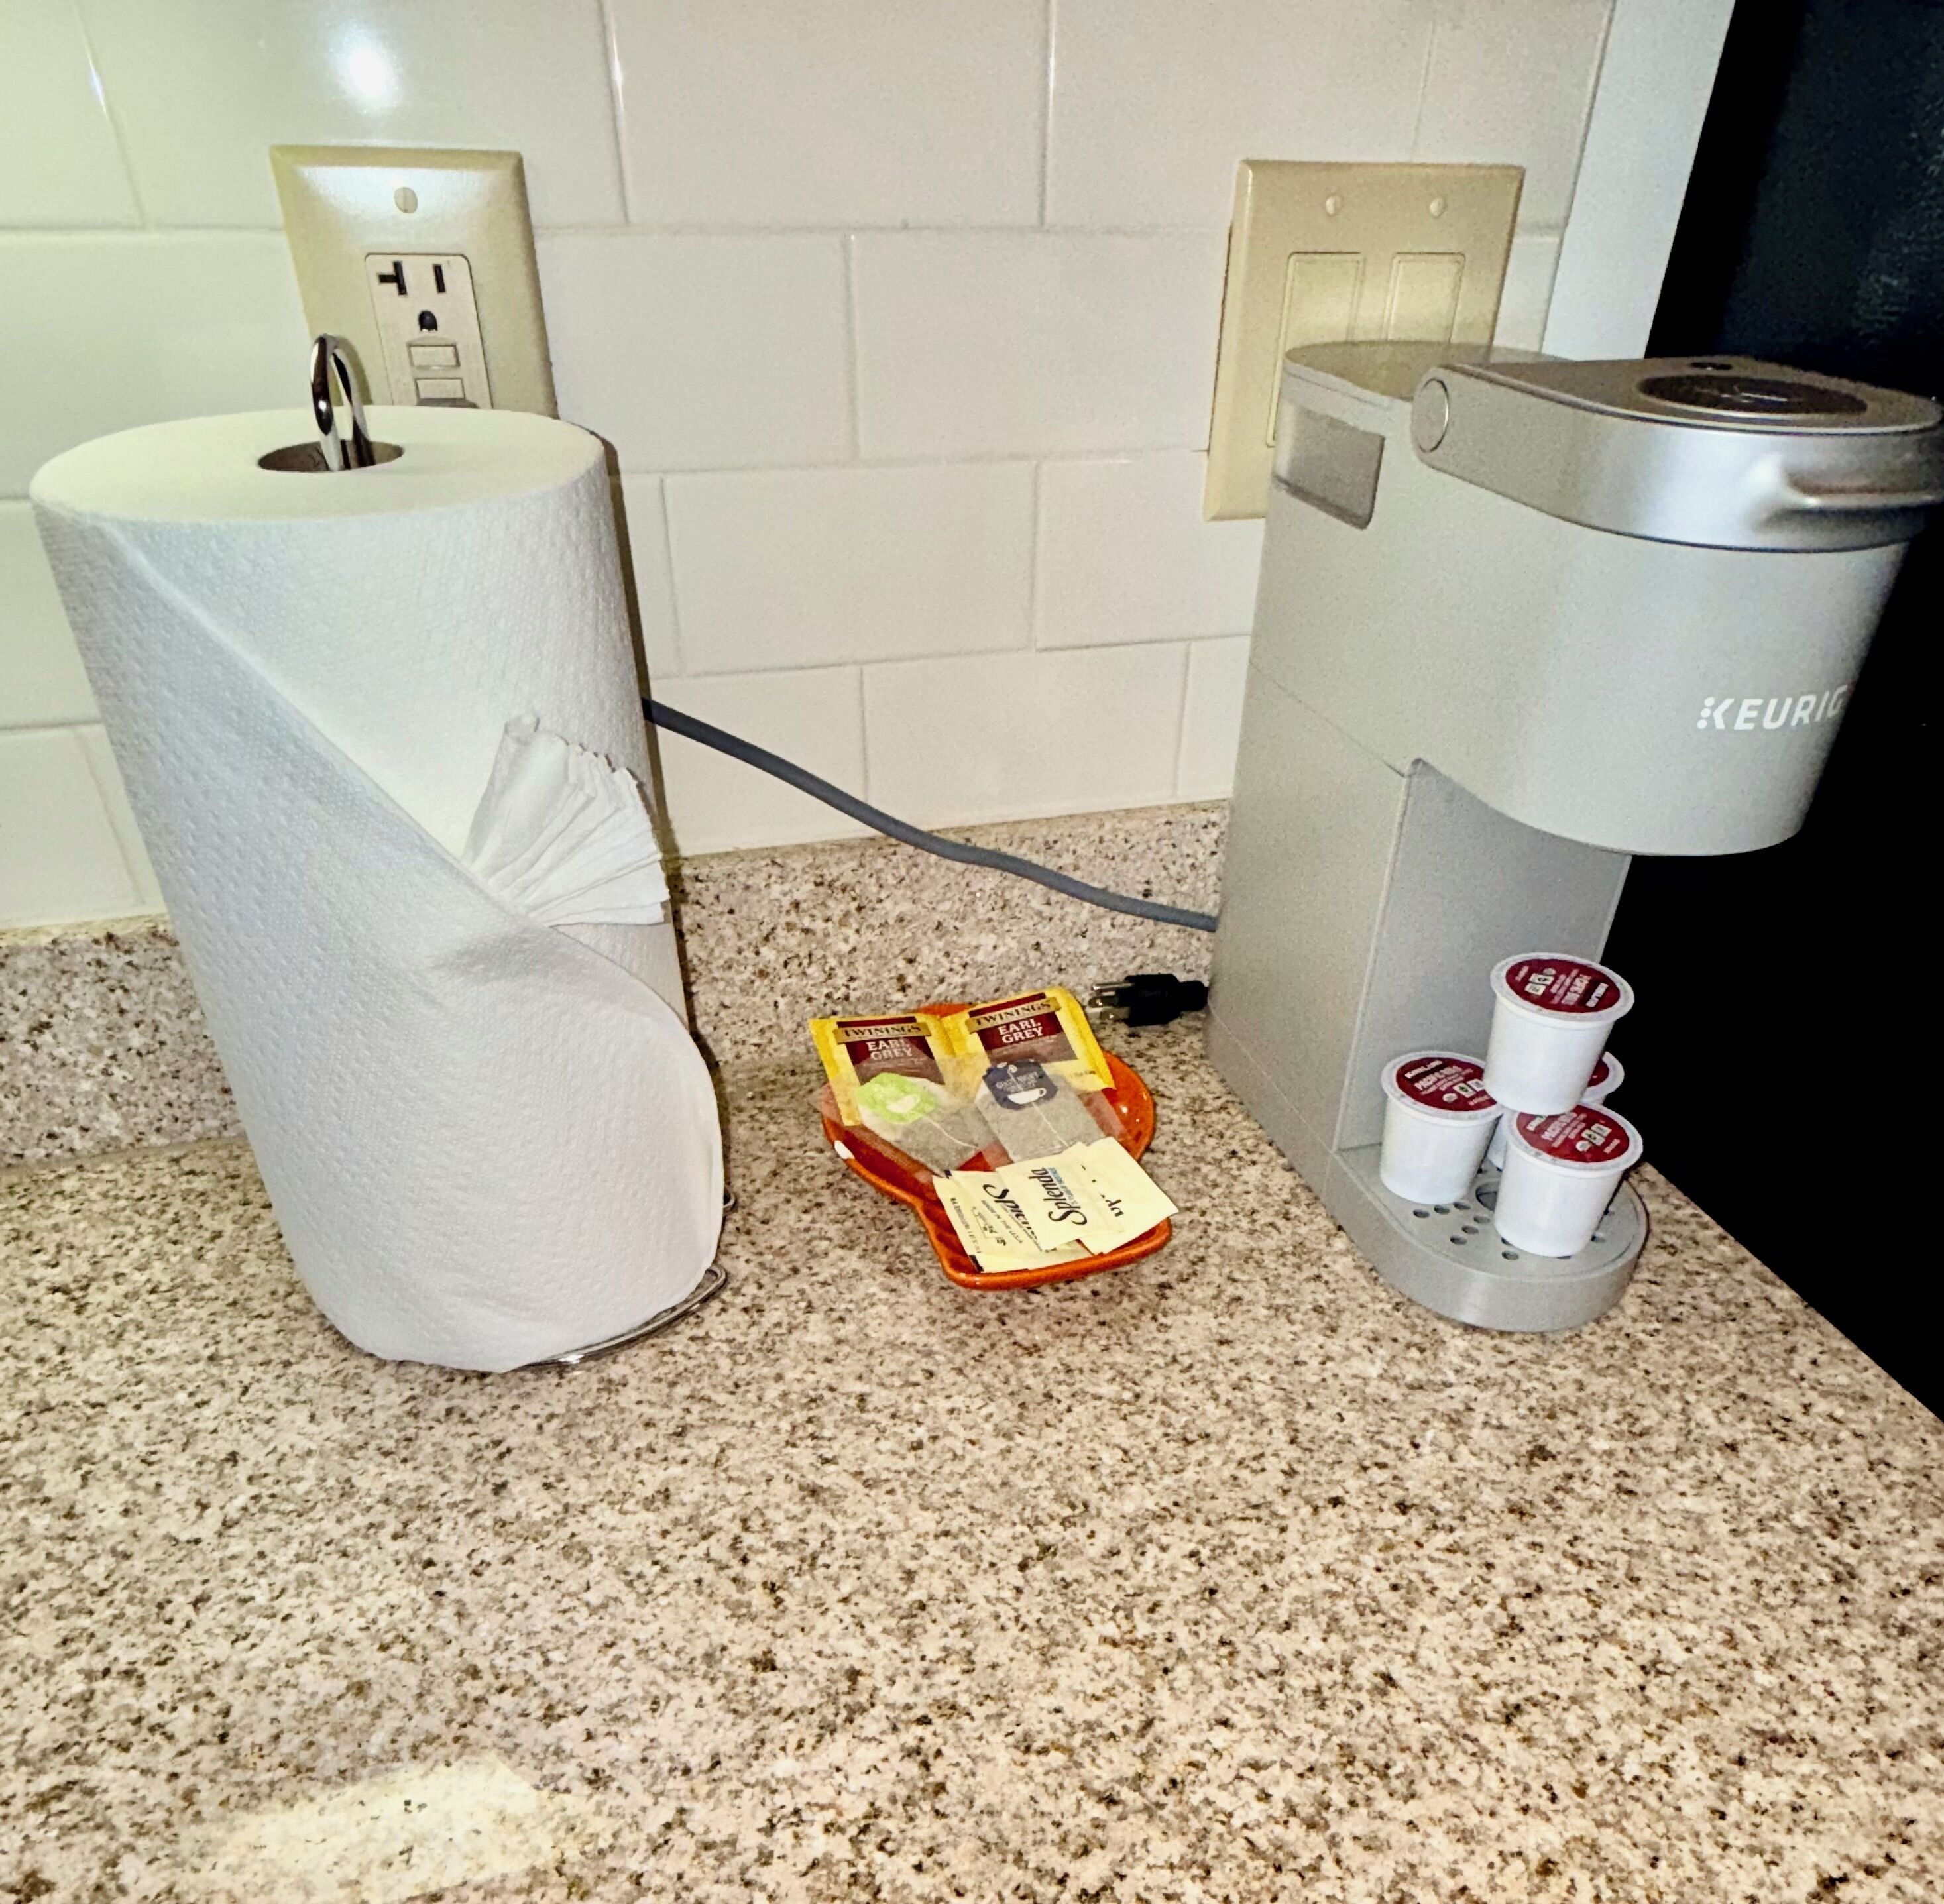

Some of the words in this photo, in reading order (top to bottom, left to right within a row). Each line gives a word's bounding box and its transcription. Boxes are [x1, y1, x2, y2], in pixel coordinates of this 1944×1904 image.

[1696, 684, 1849, 730] KEURIG
[976, 999, 1051, 1026] TWININGS
[842, 1025, 921, 1037] TWININGS
[998, 1018, 1041, 1035] EARL
[1001, 1026, 1044, 1044] GREY
[866, 1038, 911, 1052] EARL
[870, 1047, 913, 1061] GREY
[1028, 1167, 1087, 1225] Splenda
